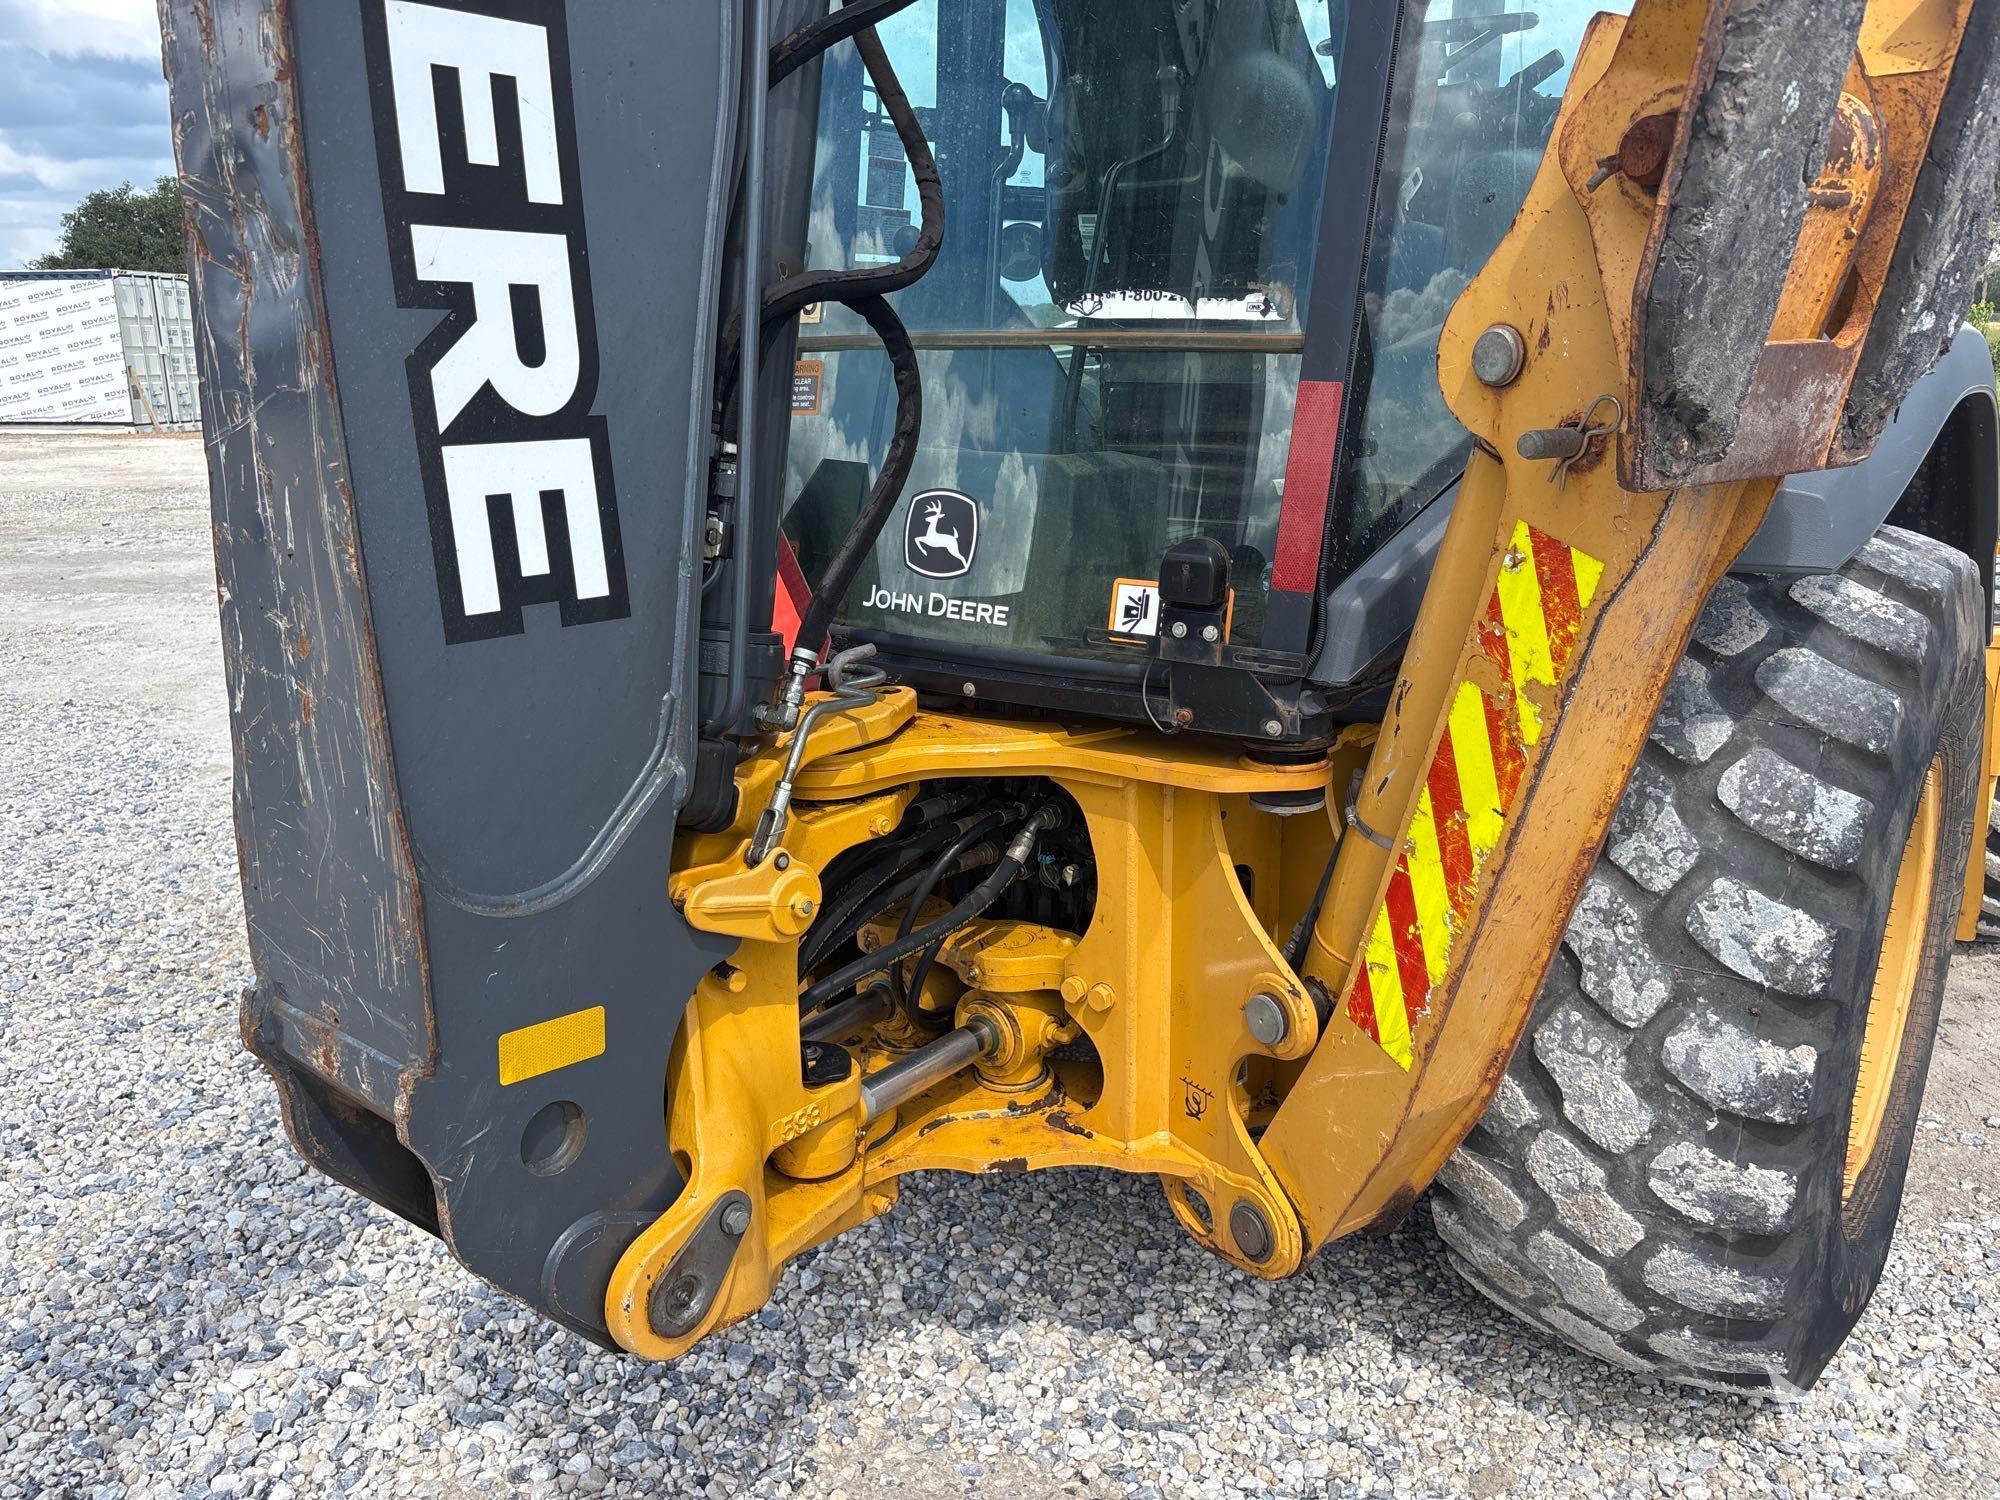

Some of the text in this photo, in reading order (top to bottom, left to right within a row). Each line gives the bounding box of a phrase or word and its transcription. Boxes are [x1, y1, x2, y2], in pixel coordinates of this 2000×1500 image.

[28, 290, 55, 300] ROYAL
[56, 303, 83, 312] ROYAL
[14, 313, 41, 322] ROYAL
[82, 316, 109, 325] ROYAL
[40, 326, 66, 336] ROYAL
[67, 339, 94, 349] ROYAL
[26, 349, 52, 358] ROYAL
[93, 352, 119, 362] ROYAL
[51, 362, 78, 371] ROYAL
[10, 371, 36, 381] ROYAL
[79, 374, 105, 384] ROYAL
[38, 384, 64, 393] ROYAL
[62, 398, 88, 407] ROYAL
[21, 406, 47, 416] ROYAL
[863, 585, 1009, 626] JOHN DEERE
